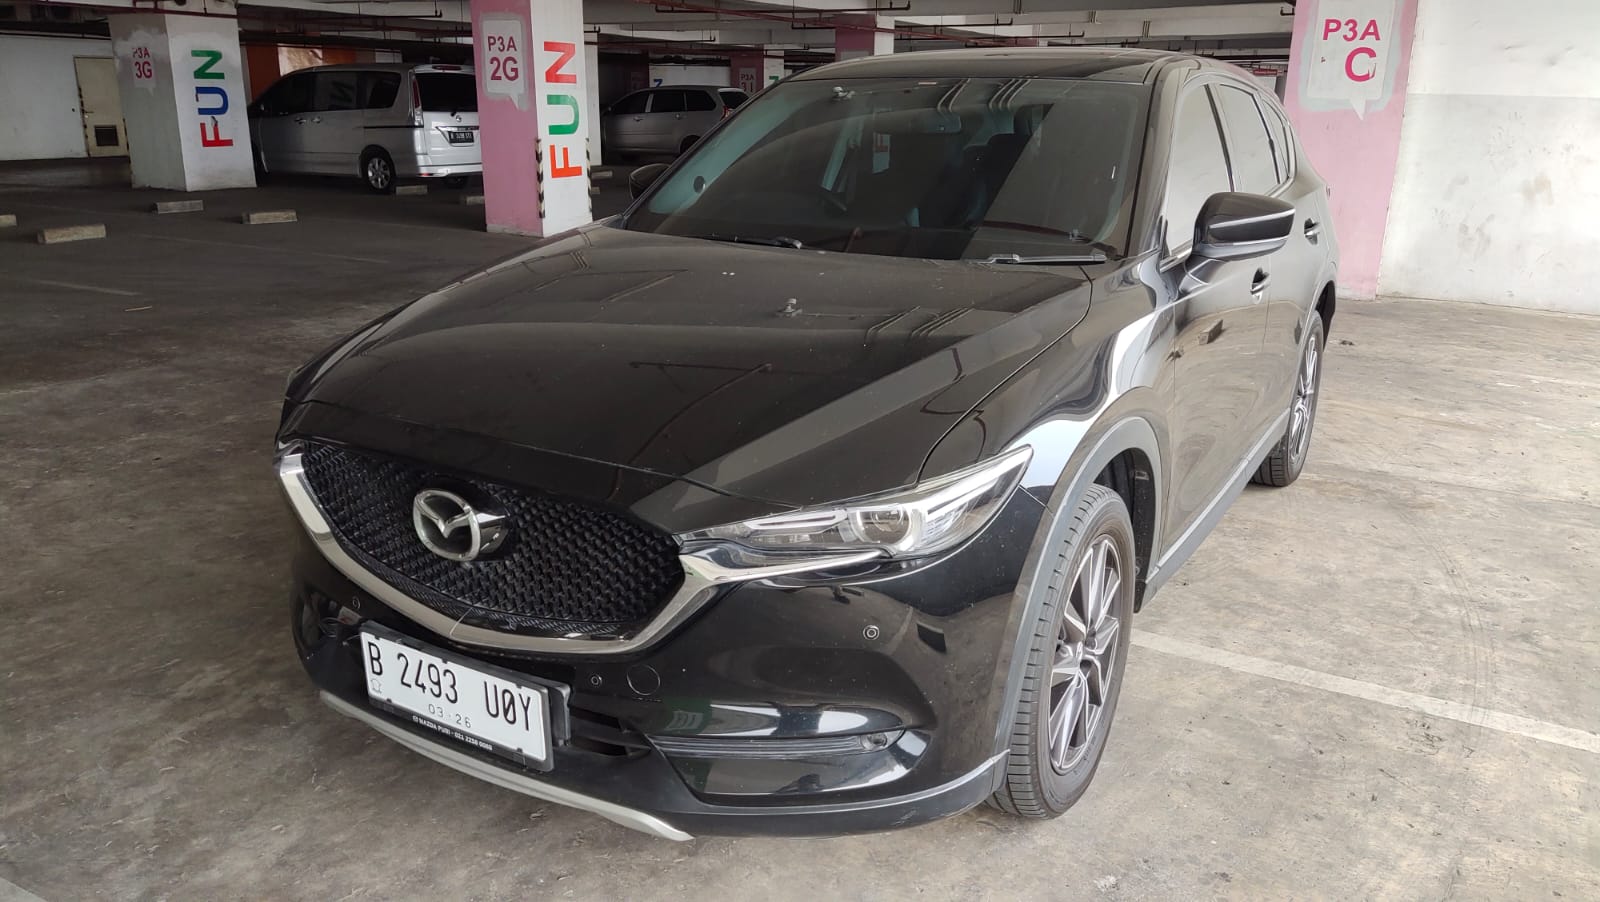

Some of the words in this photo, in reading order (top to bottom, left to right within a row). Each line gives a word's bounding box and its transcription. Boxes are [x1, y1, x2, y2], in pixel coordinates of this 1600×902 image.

[1322, 19, 1381, 42] P3A
[487, 36, 518, 52] P3A
[134, 61, 153, 79] 3G
[489, 56, 519, 82] 2G
[191, 49, 234, 148] FUN
[543, 41, 583, 179] FUN
[367, 641, 383, 676] B
[397, 653, 458, 704] 2493
